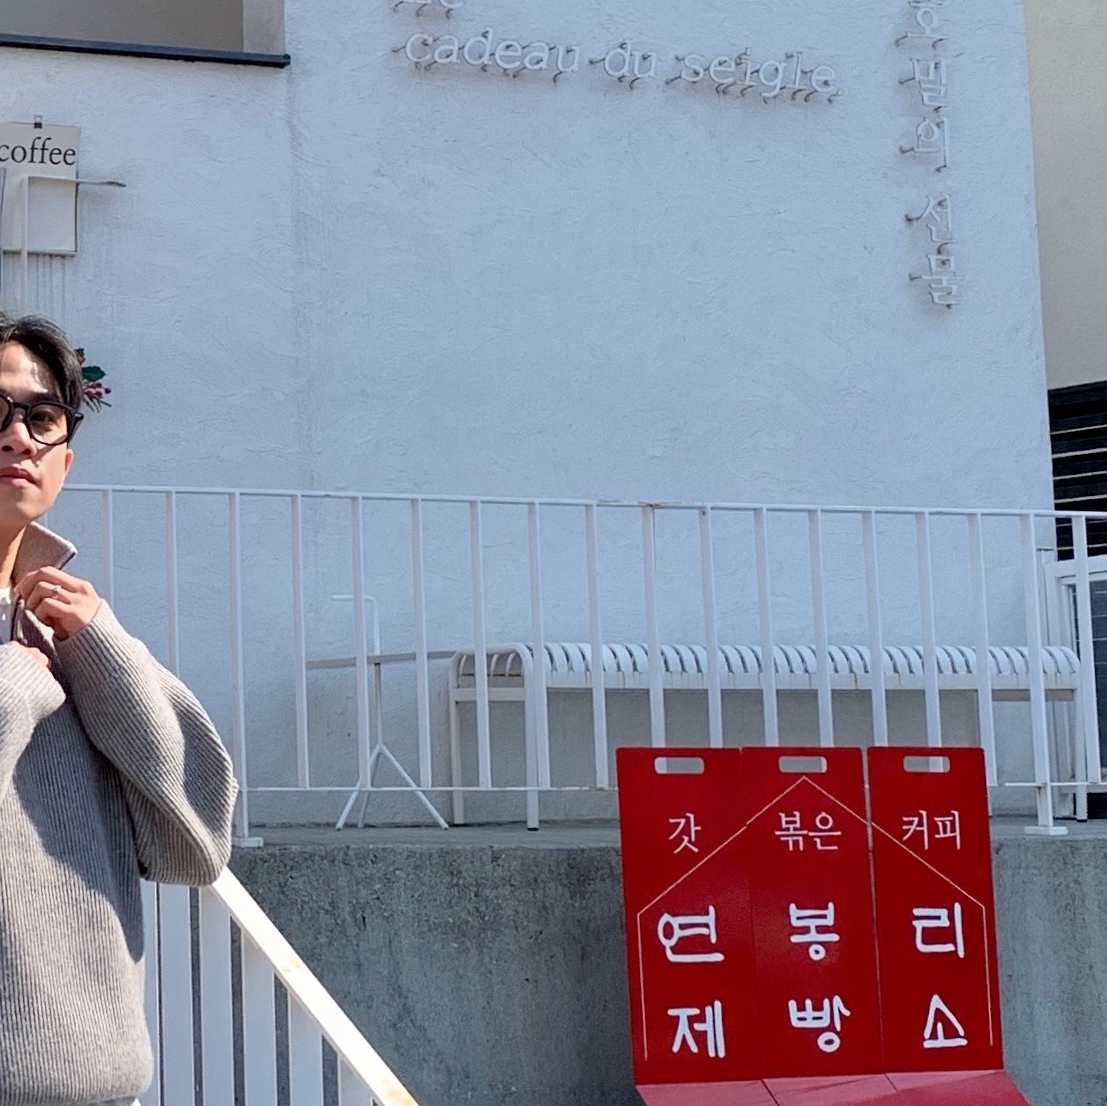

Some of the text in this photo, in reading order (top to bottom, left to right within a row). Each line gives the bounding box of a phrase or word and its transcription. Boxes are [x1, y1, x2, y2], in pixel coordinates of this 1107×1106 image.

[405, 28, 837, 98] cadeau du seigle
[919, 193, 964, 306] 선물
[668, 810, 961, 854] 갓 볶은 커피
